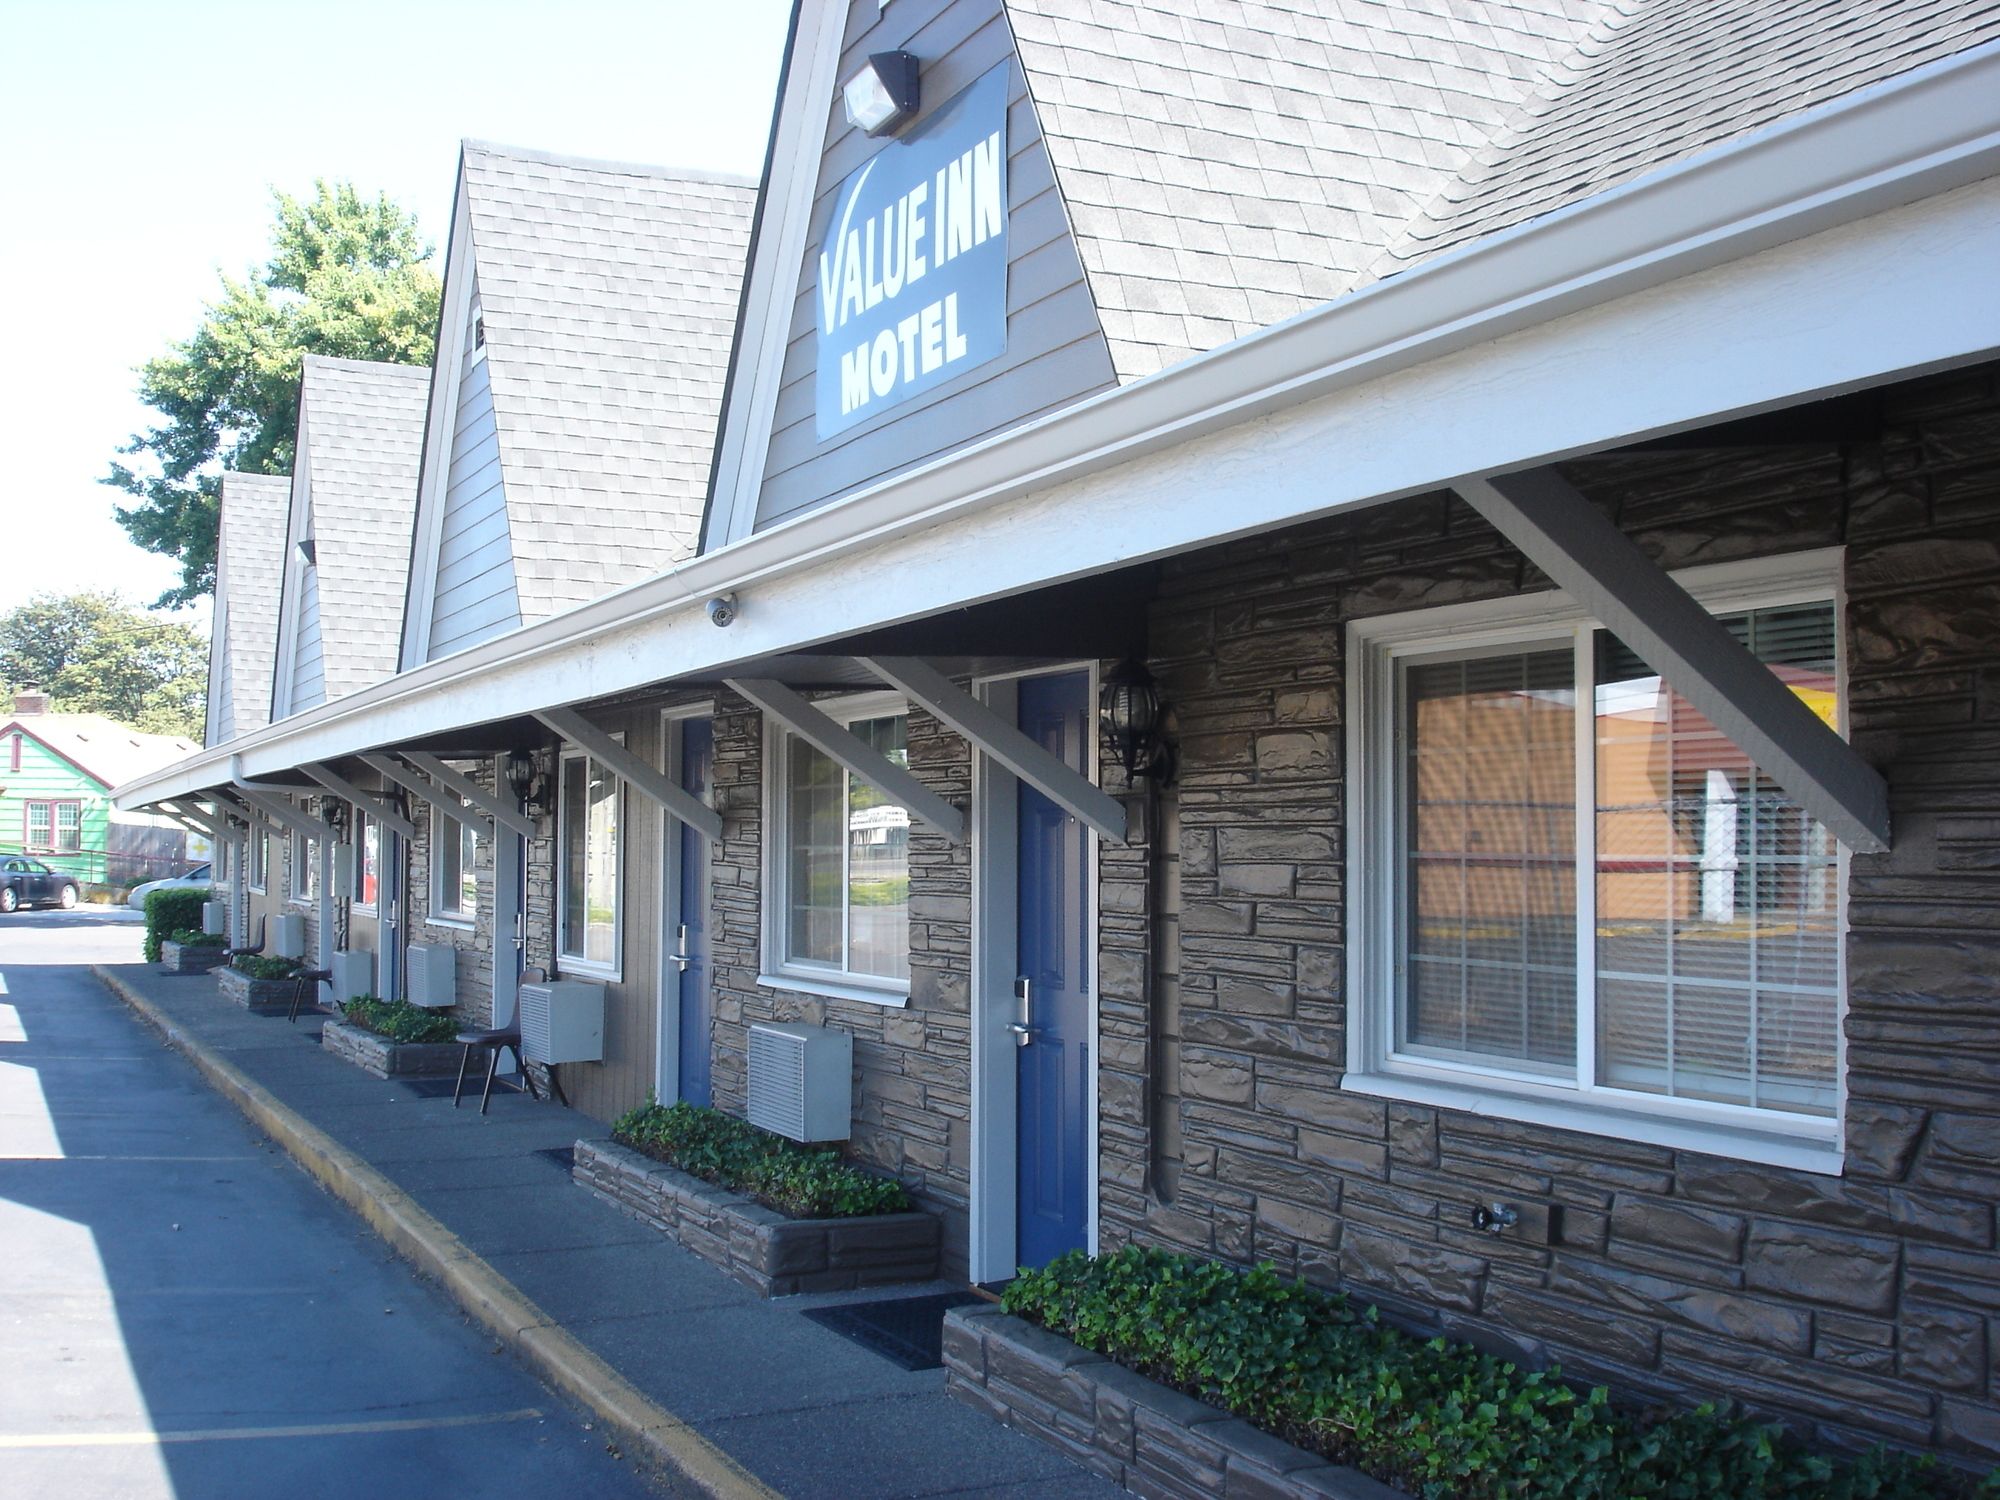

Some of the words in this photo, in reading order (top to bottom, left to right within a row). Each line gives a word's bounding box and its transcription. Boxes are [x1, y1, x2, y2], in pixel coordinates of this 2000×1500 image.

[820, 158, 928, 336] VALUE
[934, 131, 1002, 269] INN
[841, 292, 967, 416] MOTEL
